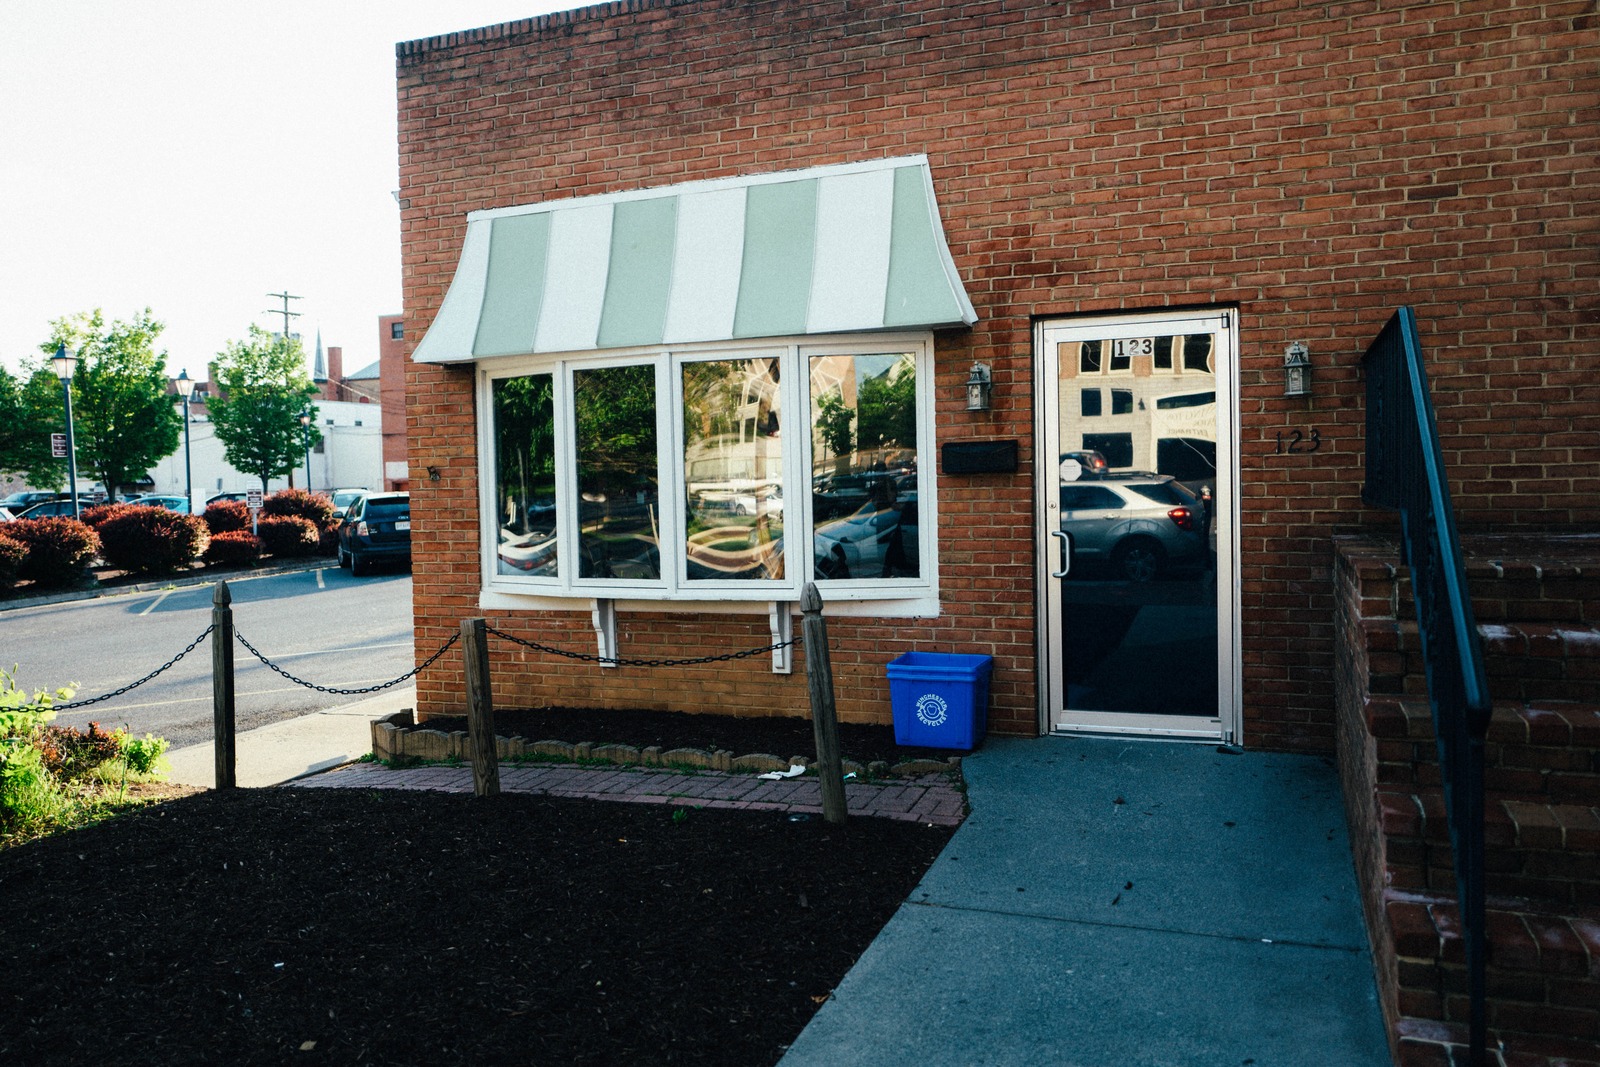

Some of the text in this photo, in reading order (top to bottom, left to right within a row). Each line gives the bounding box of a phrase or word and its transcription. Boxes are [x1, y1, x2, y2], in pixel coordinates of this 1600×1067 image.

[1117, 338, 1153, 356] 123
[1276, 428, 1321, 454] 123
[915, 693, 948, 710] WINCHESTER
